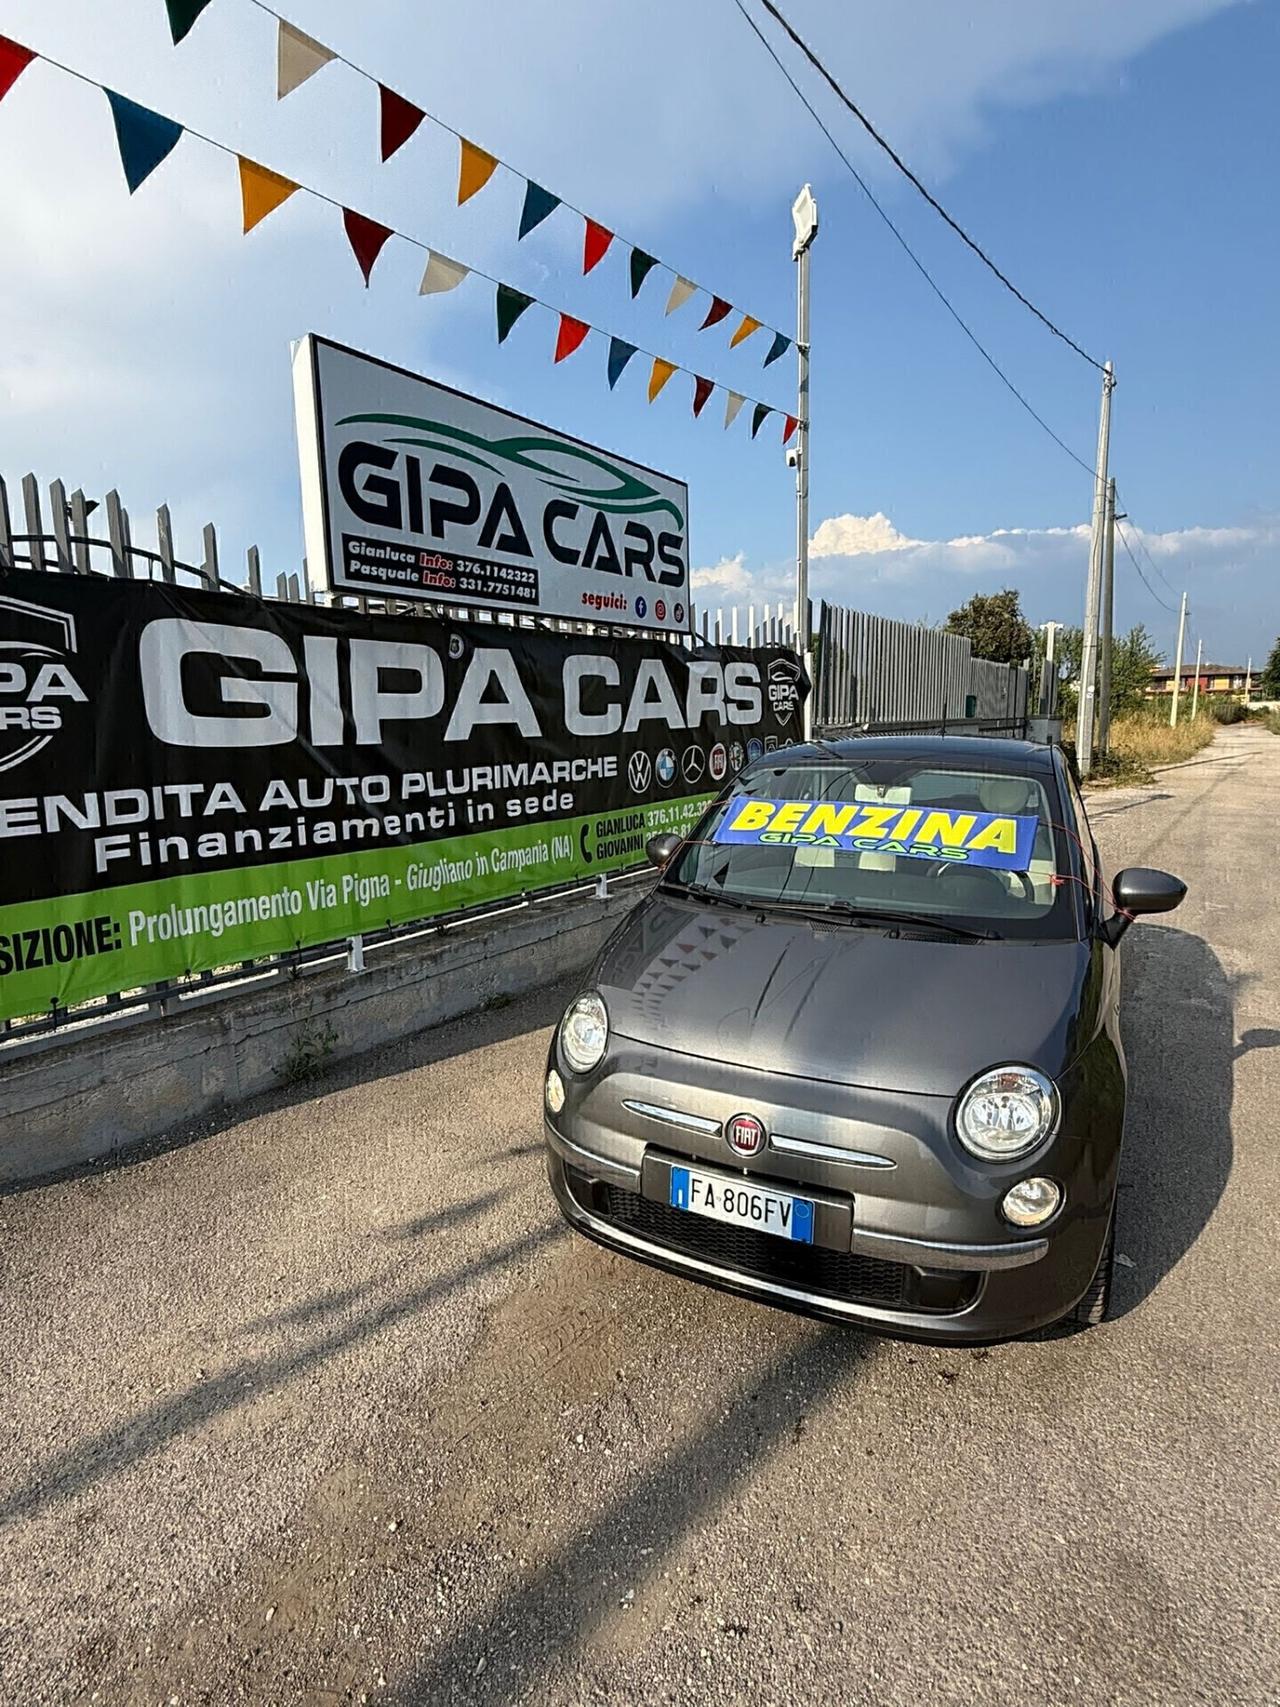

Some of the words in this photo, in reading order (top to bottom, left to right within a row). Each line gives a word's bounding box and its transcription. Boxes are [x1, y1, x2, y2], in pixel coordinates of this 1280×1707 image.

[337, 440, 535, 558] GIPA
[542, 498, 685, 588] CARS
[348, 541, 416, 563] Gianluca
[419, 552, 454, 571] Info:
[456, 560, 536, 584] 376.1142322
[349, 559, 420, 581] Pasquale
[422, 571, 457, 588] Info:
[458, 577, 537, 599] 331.7751481
[581, 592, 628, 611] seguici:
[139, 618, 543, 748] GIPA
[562, 653, 763, 737] CARS
[768, 684, 800, 701] GIPA
[773, 700, 795, 712] CARS
[0, 782, 247, 839] ENDITA
[258, 775, 391, 812] AUTO
[401, 756, 618, 800] PLURIMARCHE
[94, 802, 456, 874] Finanziamenti
[467, 799, 495, 824] in
[506, 789, 575, 818] sede
[596, 813, 646, 838] GIANLUCA
[729, 800, 1017, 854] BENZINA
[596, 834, 644, 860] GIOVANNI
[758, 832, 844, 848] GIPA
[852, 840, 970, 861] CARS
[0, 915, 123, 976] SIZIONE:
[129, 888, 303, 947] Prolungamento
[306, 877, 338, 909] Via
[342, 873, 391, 907] Pigna
[406, 859, 474, 892] Giugliano
[475, 852, 490, 876] in
[490, 841, 549, 873] Campania
[551, 835, 575, 865] (NA)
[735, 1127, 759, 1145] FIAT
